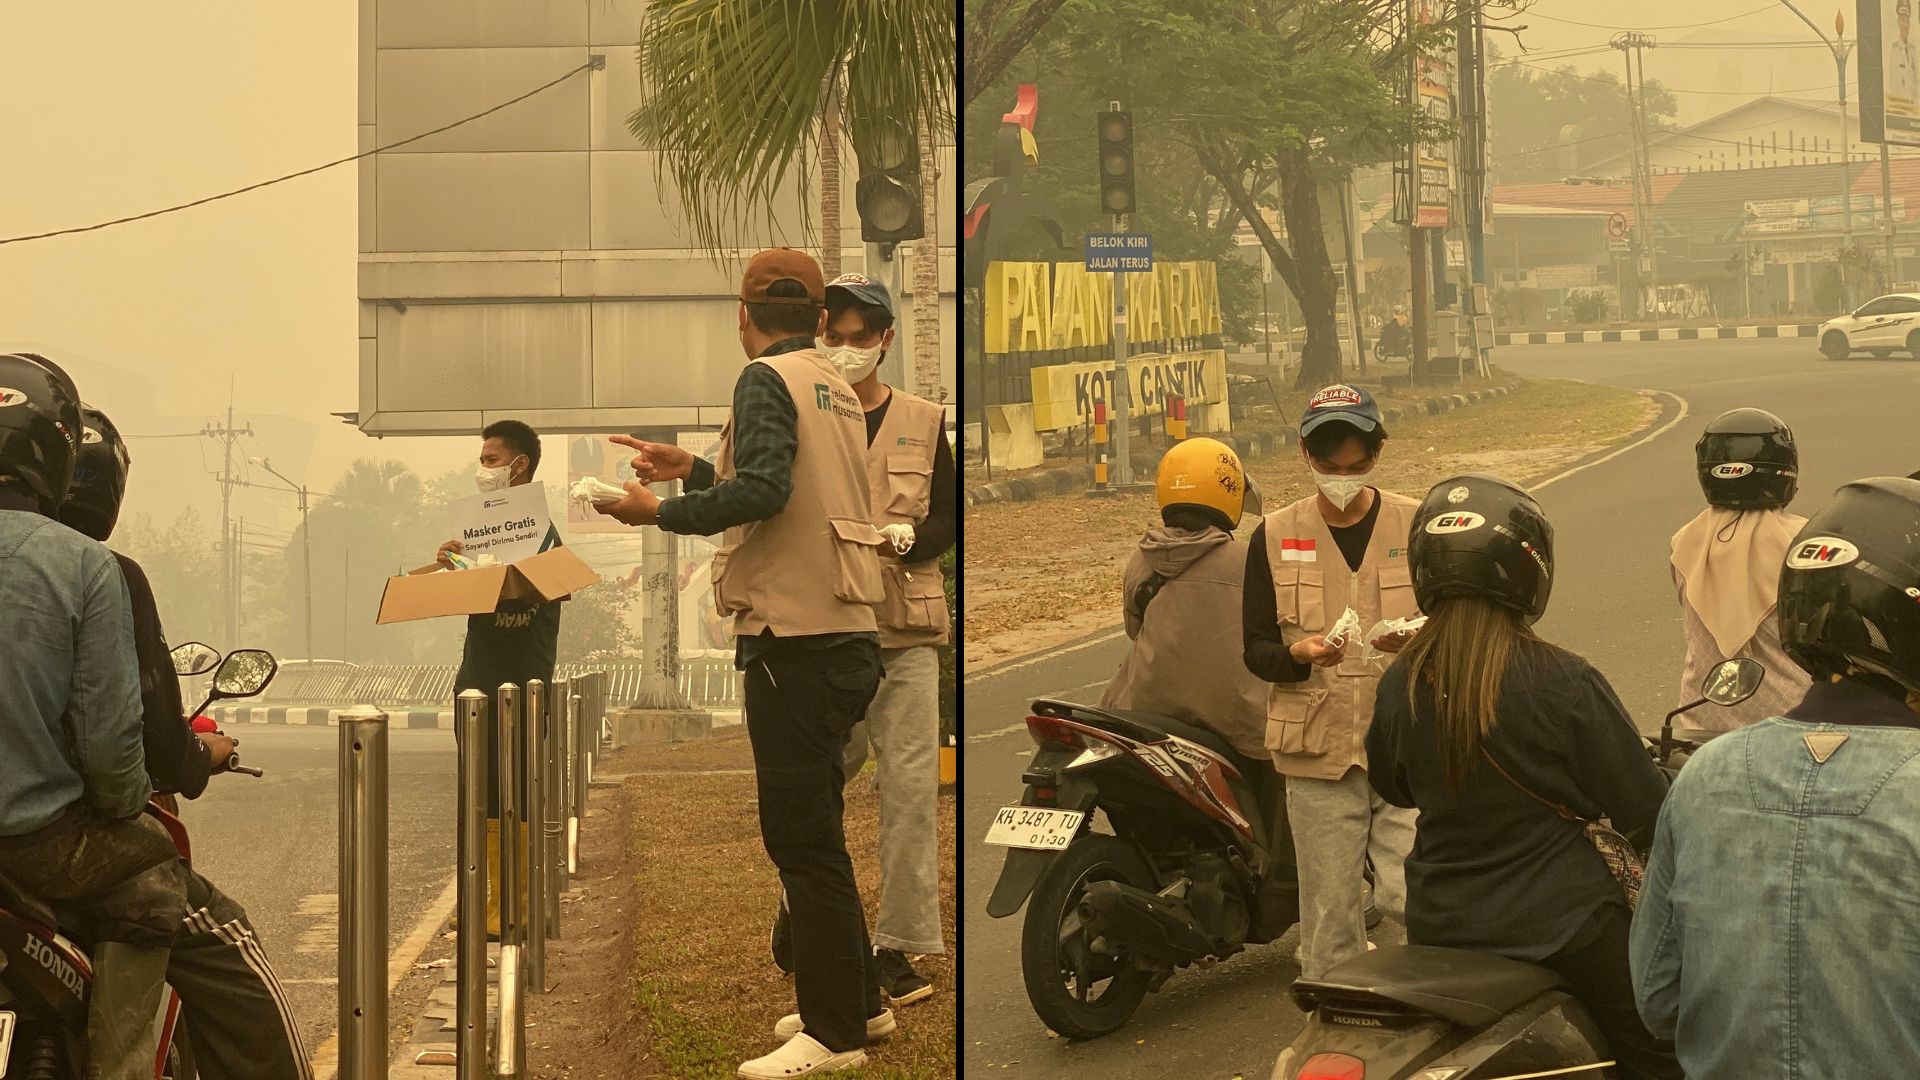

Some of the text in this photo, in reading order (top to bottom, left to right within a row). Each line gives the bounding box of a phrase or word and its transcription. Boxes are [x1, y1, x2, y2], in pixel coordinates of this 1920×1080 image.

[1090, 236, 1148, 248] BELOK KIRI
[1089, 257, 1150, 269] JALAN TERUS
[1140, 360, 1206, 407] CANTIK
[1312, 390, 1358, 403] RELIABLE
[1719, 466, 1745, 475] GM
[463, 516, 536, 540] Masker Gratis
[1436, 516, 1474, 527] GM
[465, 531, 538, 551] Sayangi Dirimu Sendiri
[1797, 543, 1843, 562] GM
[996, 809, 1079, 829] KH 3487 TU
[23, 932, 84, 1001] HONDA
[1332, 1015, 1382, 1026] HONDA
